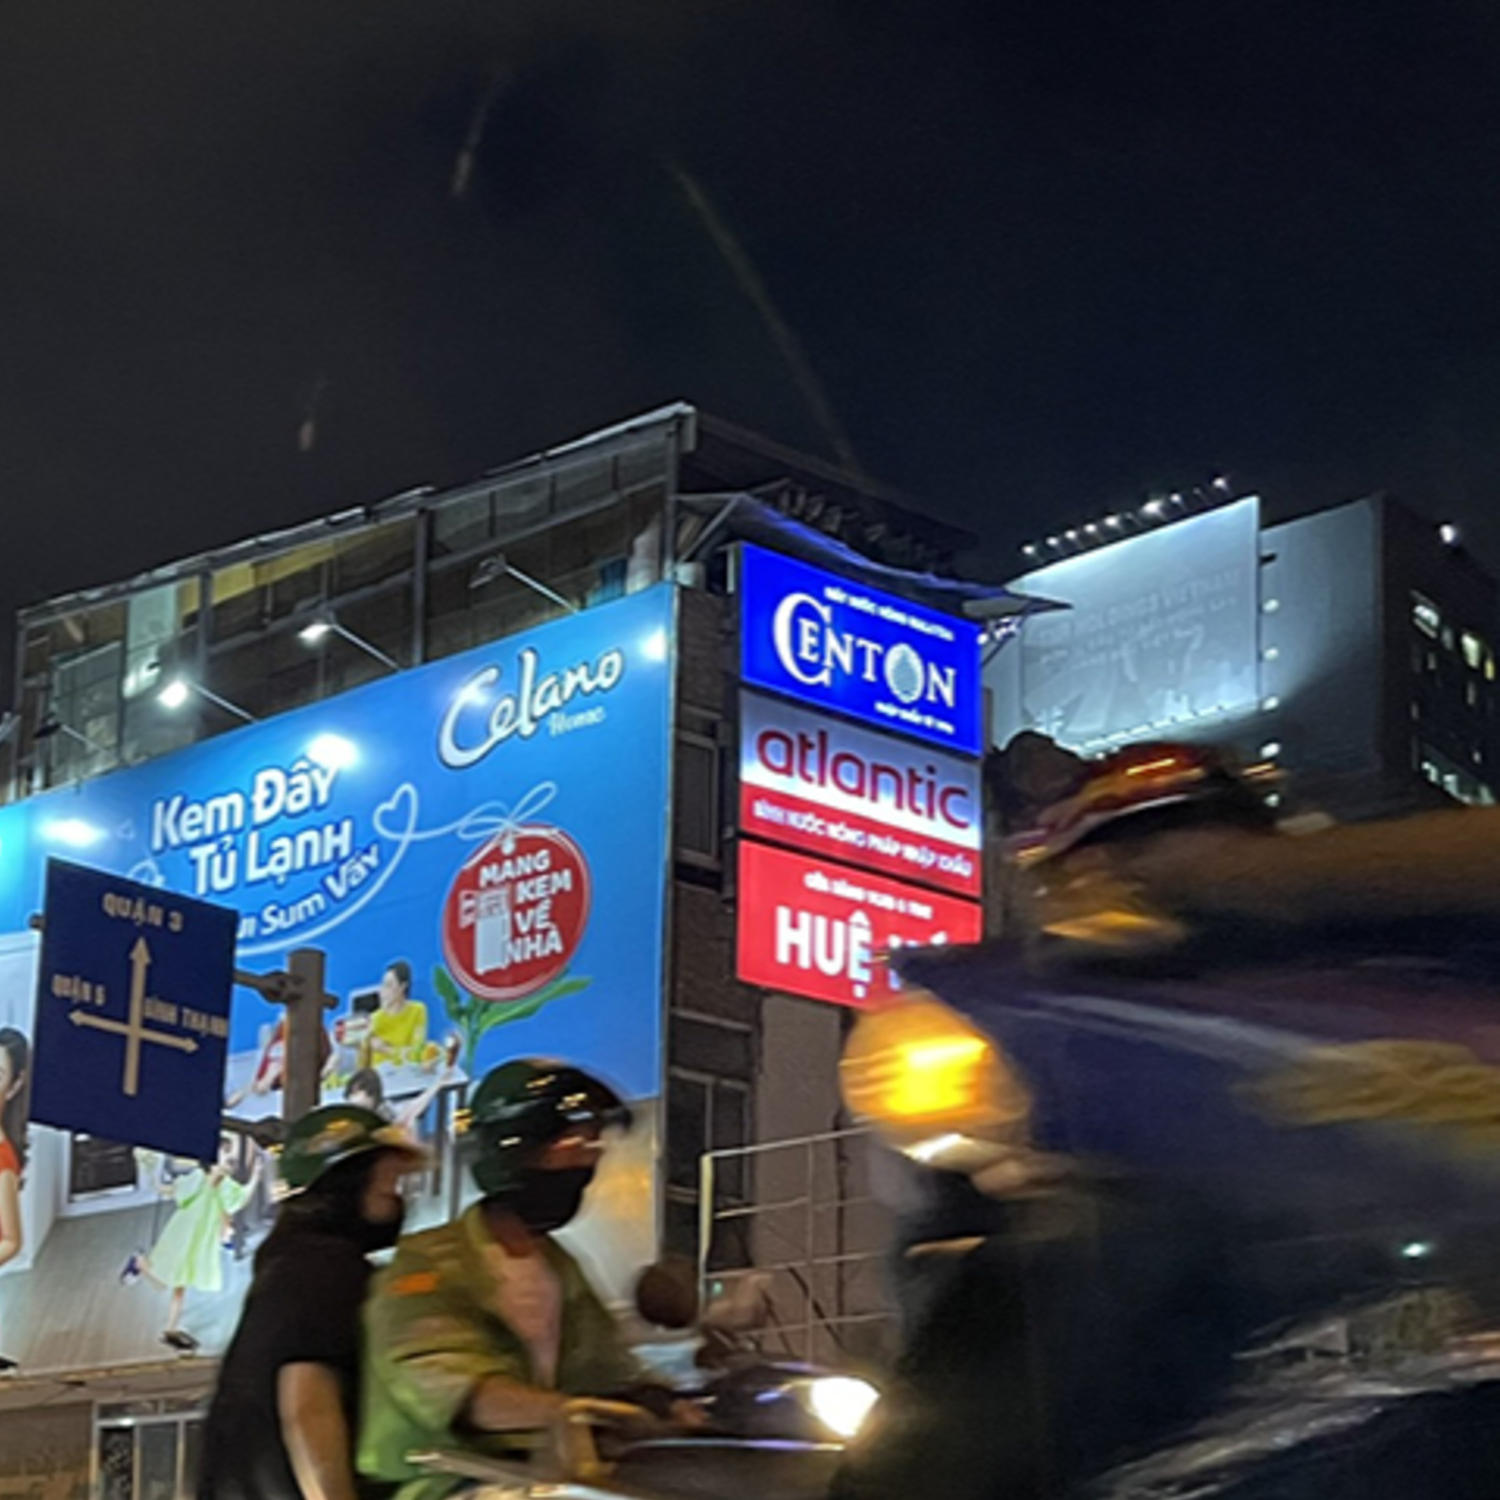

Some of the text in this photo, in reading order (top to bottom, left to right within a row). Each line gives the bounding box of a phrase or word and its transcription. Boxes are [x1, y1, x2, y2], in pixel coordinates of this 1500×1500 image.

[438, 648, 623, 769] Celano
[756, 729, 970, 830] atlantic
[152, 794, 244, 851] Kem
[479, 849, 551, 888] MANG
[515, 868, 572, 904] KEM
[260, 892, 326, 936] Sum
[775, 904, 873, 999] HUỆ
